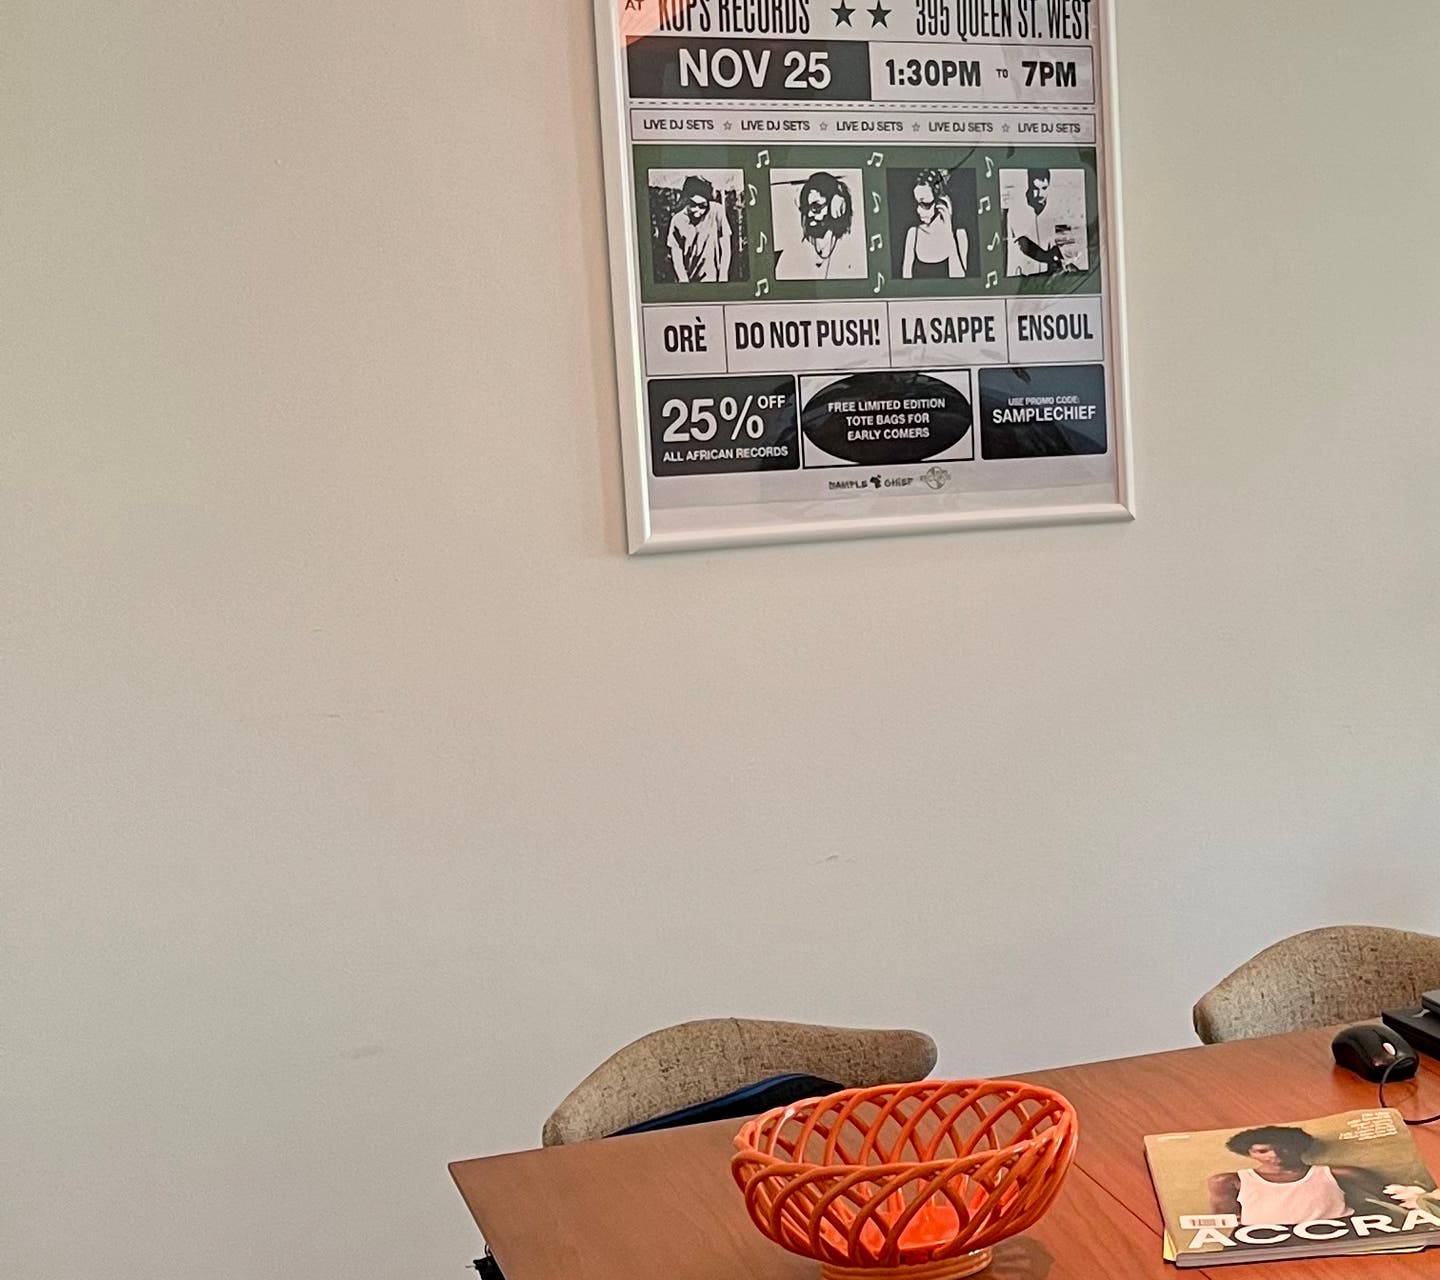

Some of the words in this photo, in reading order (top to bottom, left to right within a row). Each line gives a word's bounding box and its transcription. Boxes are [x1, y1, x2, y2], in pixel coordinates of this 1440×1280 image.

[678, 47, 771, 89] NOV
[783, 49, 832, 90] 25
[885, 58, 982, 88] 1:30PM
[996, 67, 1009, 79] TO
[1021, 60, 1077, 88] 7PM
[643, 119, 667, 131] LIVE
[669, 119, 684, 131] DJ
[686, 119, 715, 131] SETS
[740, 120, 765, 132] LIVE
[766, 120, 781, 132] DJ
[783, 120, 811, 132] SETS
[836, 121, 860, 132] LIVE
[861, 121, 875, 132] DJ
[876, 121, 904, 132] SETS
[928, 122, 950, 133] LIVE
[952, 122, 967, 133] DJ
[967, 122, 994, 133] SETS
[1017, 123, 1040, 134] LIVE
[1041, 123, 1054, 134] DJ
[1055, 123, 1081, 134] SETS
[663, 316, 708, 353] ORÈ
[734, 321, 765, 350] DO
[769, 320, 812, 349] NOT
[816, 318, 881, 348] PUSH!
[901, 317, 927, 345] LA
[930, 315, 996, 345] SAPPE
[1017, 313, 1094, 342] ENSOUL
[827, 401, 857, 413] FREE
[858, 399, 901, 412] LIMITED
[903, 397, 946, 410] EDITION
[661, 394, 764, 443] 25%
[757, 394, 786, 410] OFF
[846, 415, 874, 427] TOTE
[876, 413, 906, 426] BAGS
[907, 412, 930, 424] FOR
[992, 404, 1097, 425] SAMPLECHIEF
[847, 429, 881, 442] EARLY
[883, 427, 930, 440] COMERS
[663, 450, 684, 463] ALL
[686, 448, 733, 462] AFRICAN
[735, 445, 789, 459] RECORDS
